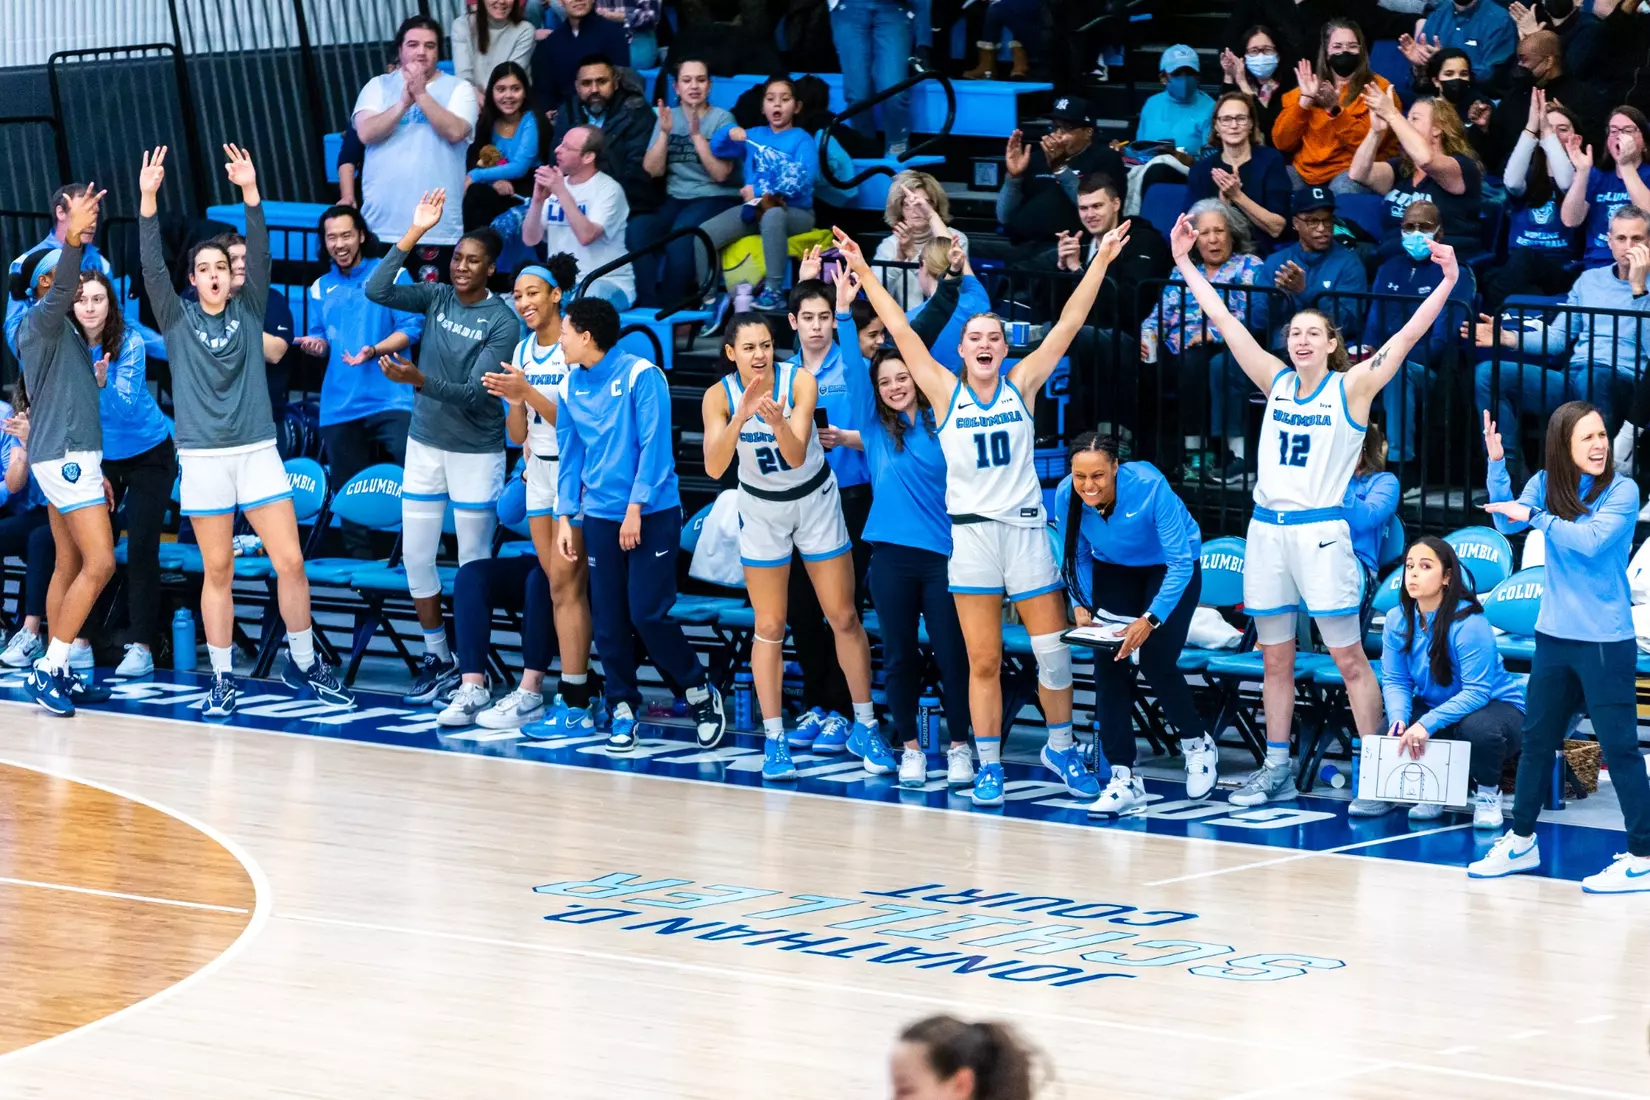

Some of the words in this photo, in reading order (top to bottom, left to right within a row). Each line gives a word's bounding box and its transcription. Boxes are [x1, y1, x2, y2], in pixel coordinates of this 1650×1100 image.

[1312, 187, 1323, 199] C
[611, 380, 623, 397] C
[956, 410, 1024, 429] COLUMBIA
[973, 430, 1012, 469] 10
[1278, 429, 1311, 468] 12
[346, 478, 403, 499] COLUMBIA
[1276, 512, 1285, 524] C
[1453, 541, 1499, 563] LUMBIA
[1200, 553, 1245, 574] LUMBI
[1497, 583, 1545, 602] COLUM
[543, 903, 643, 924] D.
[860, 883, 1200, 927] COURT
[531, 872, 1347, 981] SCHILLER
[620, 916, 1138, 987] JONATHAN
